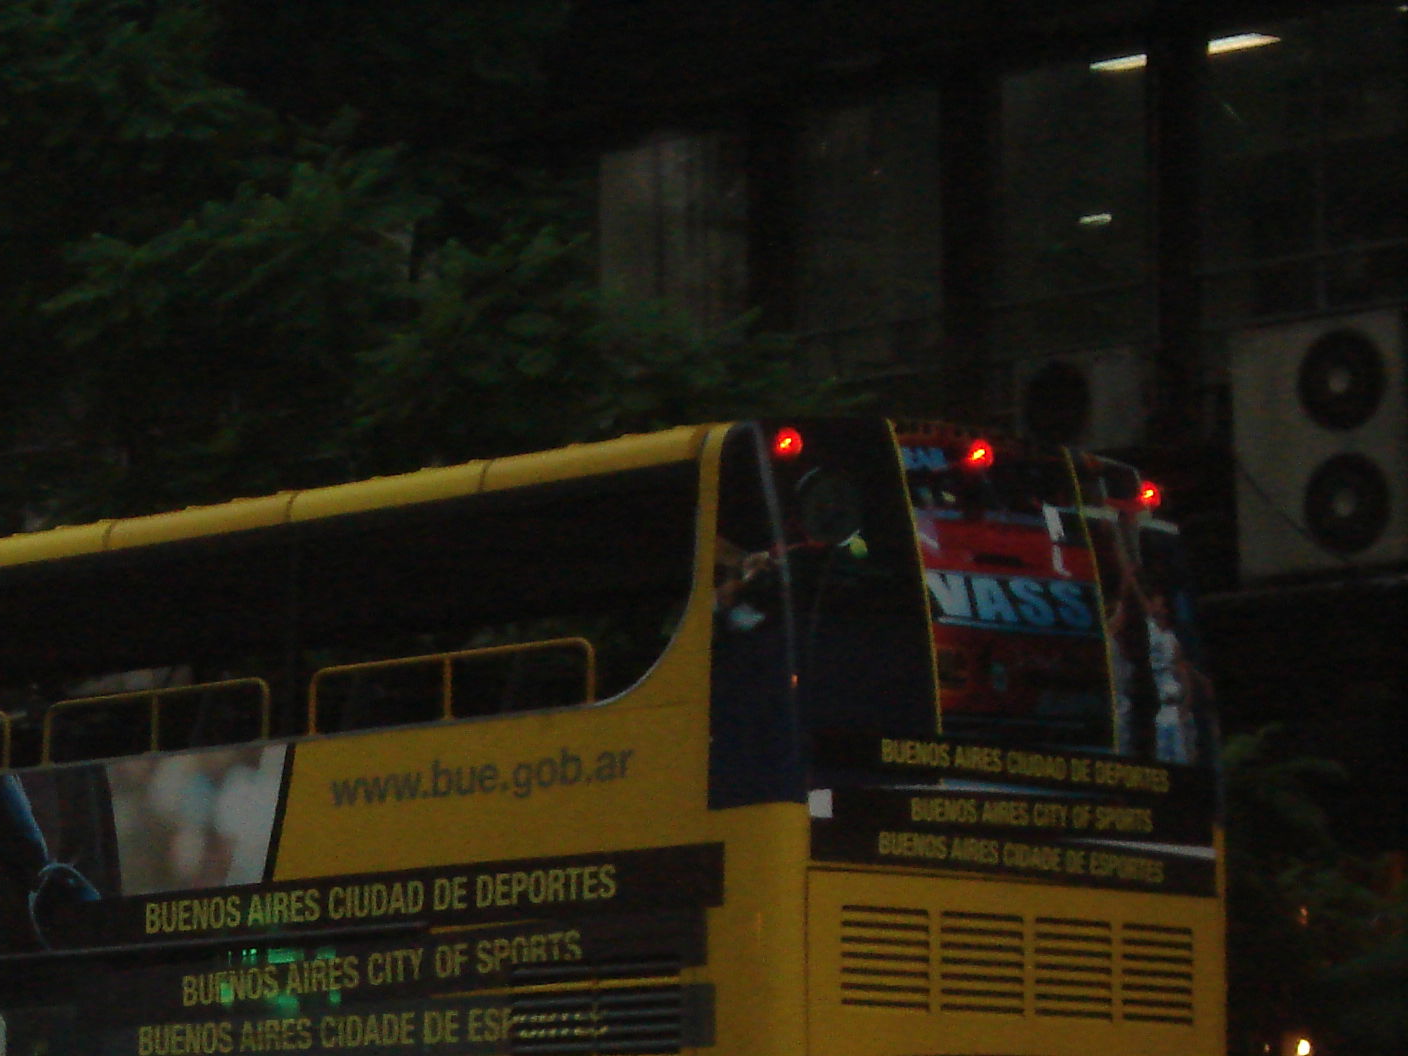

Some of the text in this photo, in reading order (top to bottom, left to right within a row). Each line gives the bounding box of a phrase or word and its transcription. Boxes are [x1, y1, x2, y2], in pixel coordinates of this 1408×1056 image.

[330, 747, 634, 808] www.bue.gob.ar
[880, 737, 1170, 793] BUENOS AIRES CIUDAD DE DEPORTES
[910, 797, 1153, 833] BUENOS AIRES CITY OF SPORTS
[878, 831, 1165, 883] BUENOS AIRES CIDADE DE ESPORTES
[145, 864, 617, 934] BUENOS AIRES CIUDAD DE DEPORTES
[182, 929, 584, 1006] BUENOS AIRES CITY OF SPORTS
[138, 1022, 233, 1056] BUENOS
[240, 1017, 312, 1052] AIRES
[320, 1011, 415, 1048] CIDADE
[424, 1009, 460, 1043] DE
